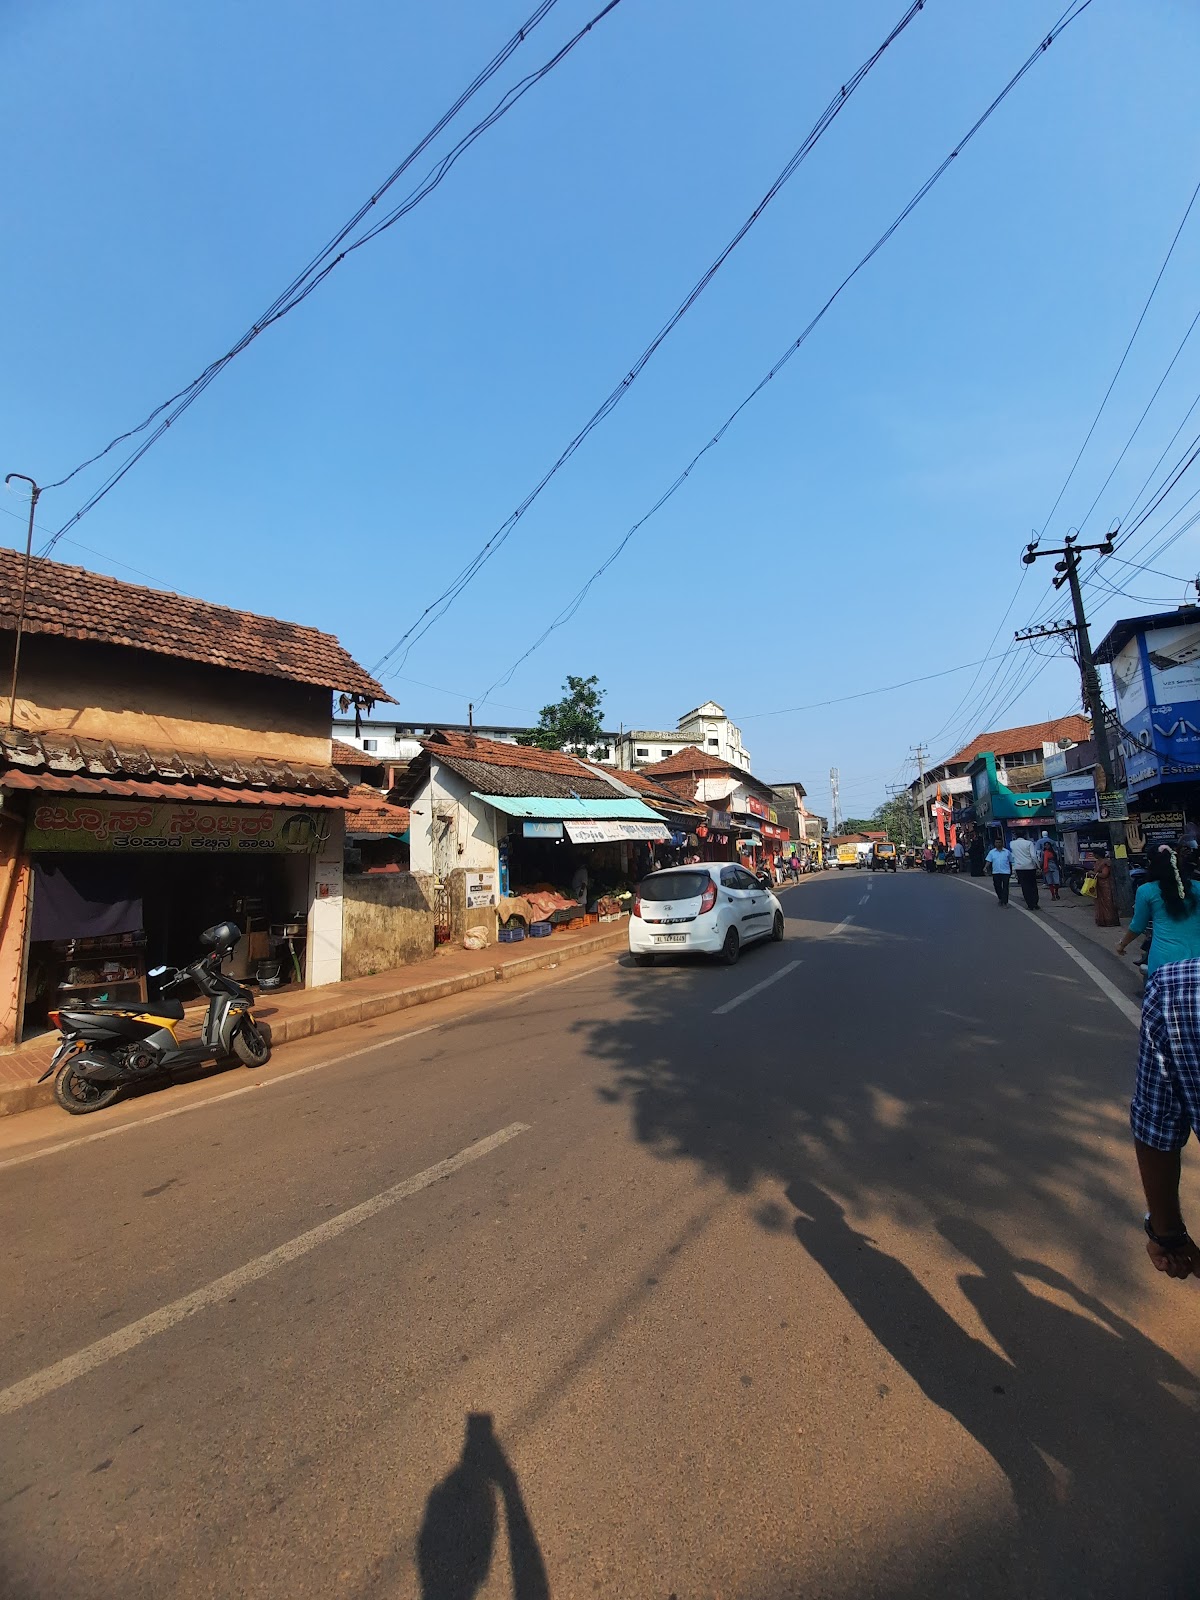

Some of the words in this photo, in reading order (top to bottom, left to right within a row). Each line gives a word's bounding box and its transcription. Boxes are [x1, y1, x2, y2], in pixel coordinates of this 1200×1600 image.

[34, 806, 155, 840] ಜ್ಯೂಸ್
[170, 808, 275, 836] ಸೆಂಟರ್
[112, 835, 183, 849] ತಂಪಾದ
[190, 836, 231, 850] ಕಬ್ಬಿನ
[238, 837, 275, 849] ಹಾಲು
